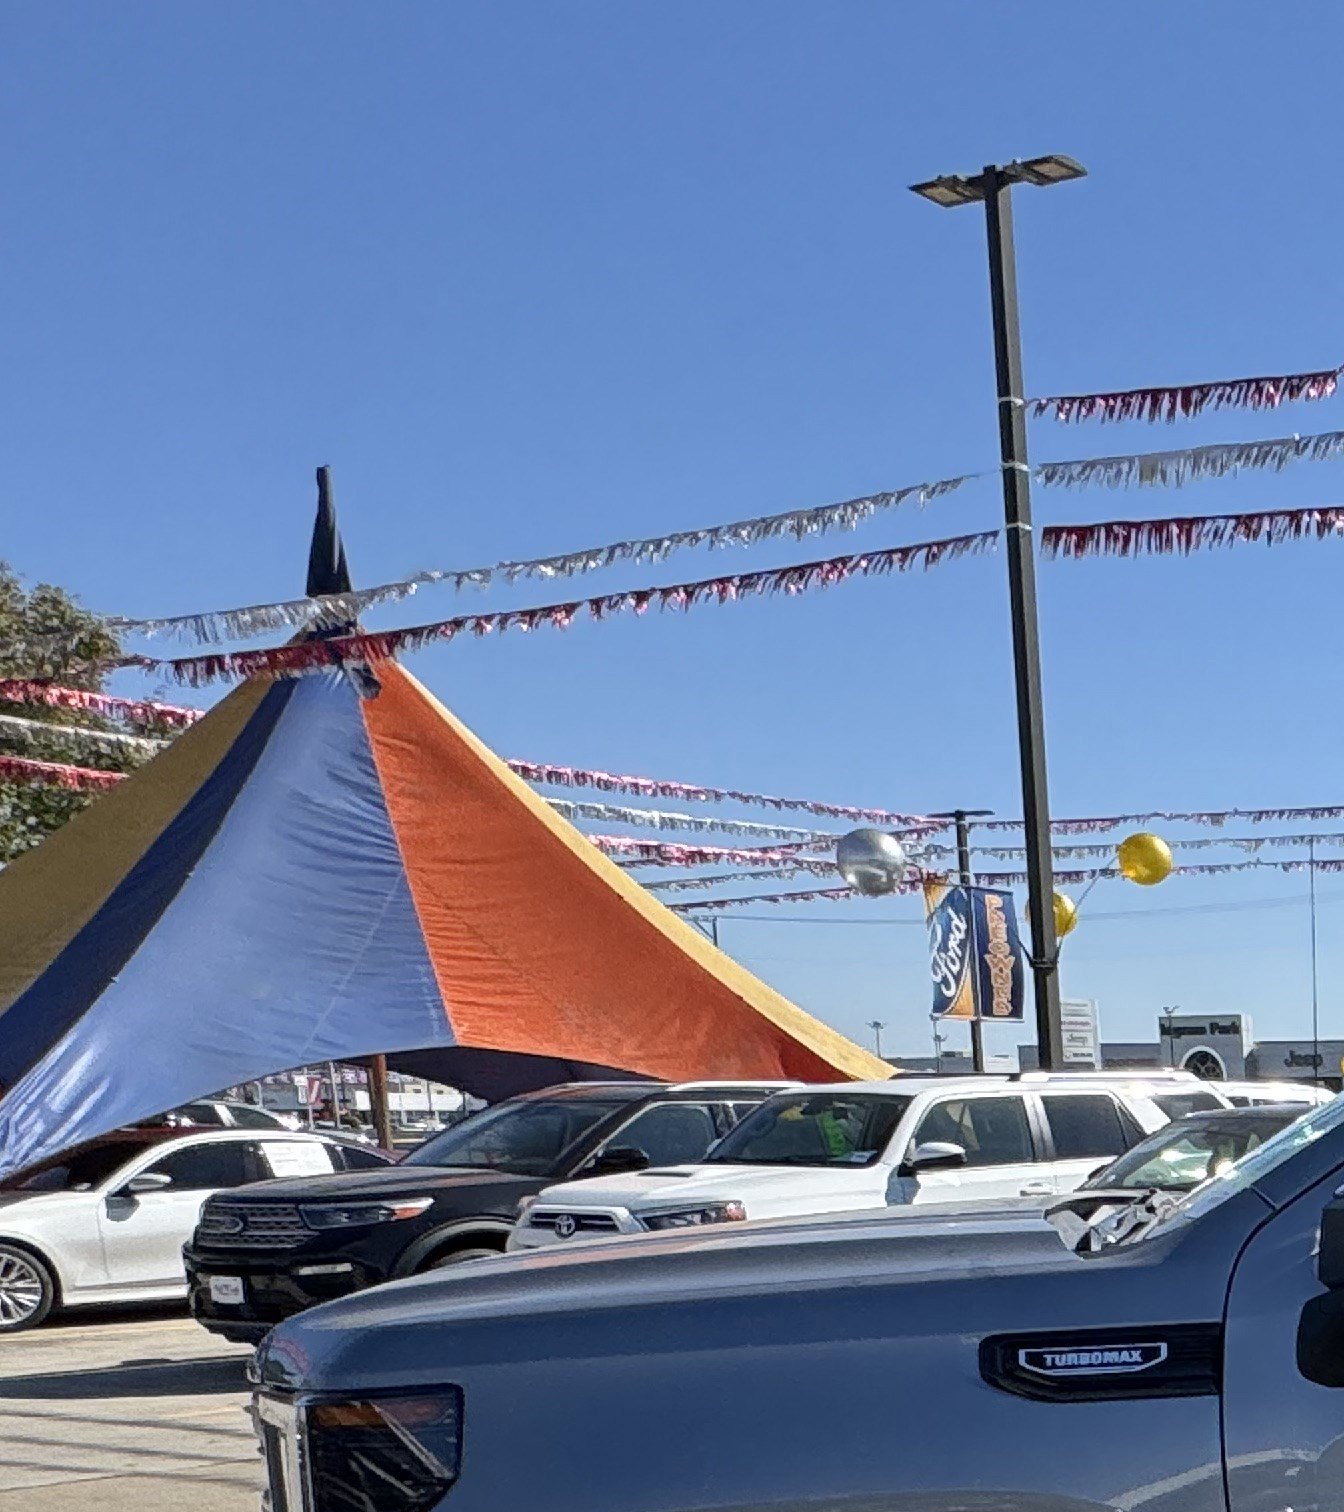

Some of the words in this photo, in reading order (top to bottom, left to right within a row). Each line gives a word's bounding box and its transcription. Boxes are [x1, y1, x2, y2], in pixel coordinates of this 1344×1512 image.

[930, 906, 968, 998] Ford
[983, 894, 1016, 1016] PREOWNED
[1043, 1350, 1143, 1367] TURBOMAX
